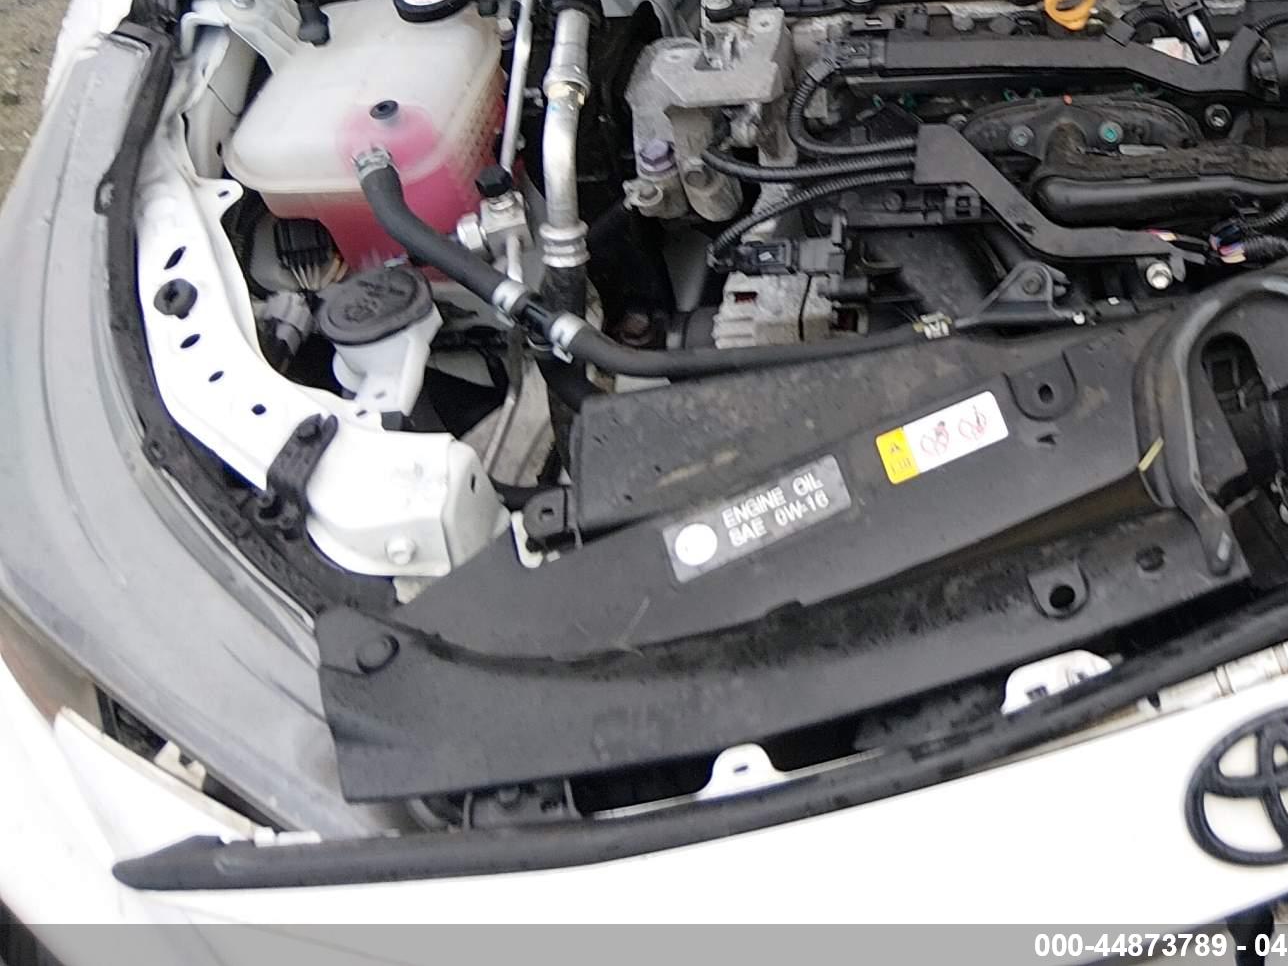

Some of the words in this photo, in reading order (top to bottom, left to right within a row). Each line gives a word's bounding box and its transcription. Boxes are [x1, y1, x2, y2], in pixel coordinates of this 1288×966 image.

[721, 486, 787, 529] ENGINE
[792, 472, 825, 497] OIL
[728, 516, 768, 547] SAE
[774, 489, 829, 526] 0W-16
